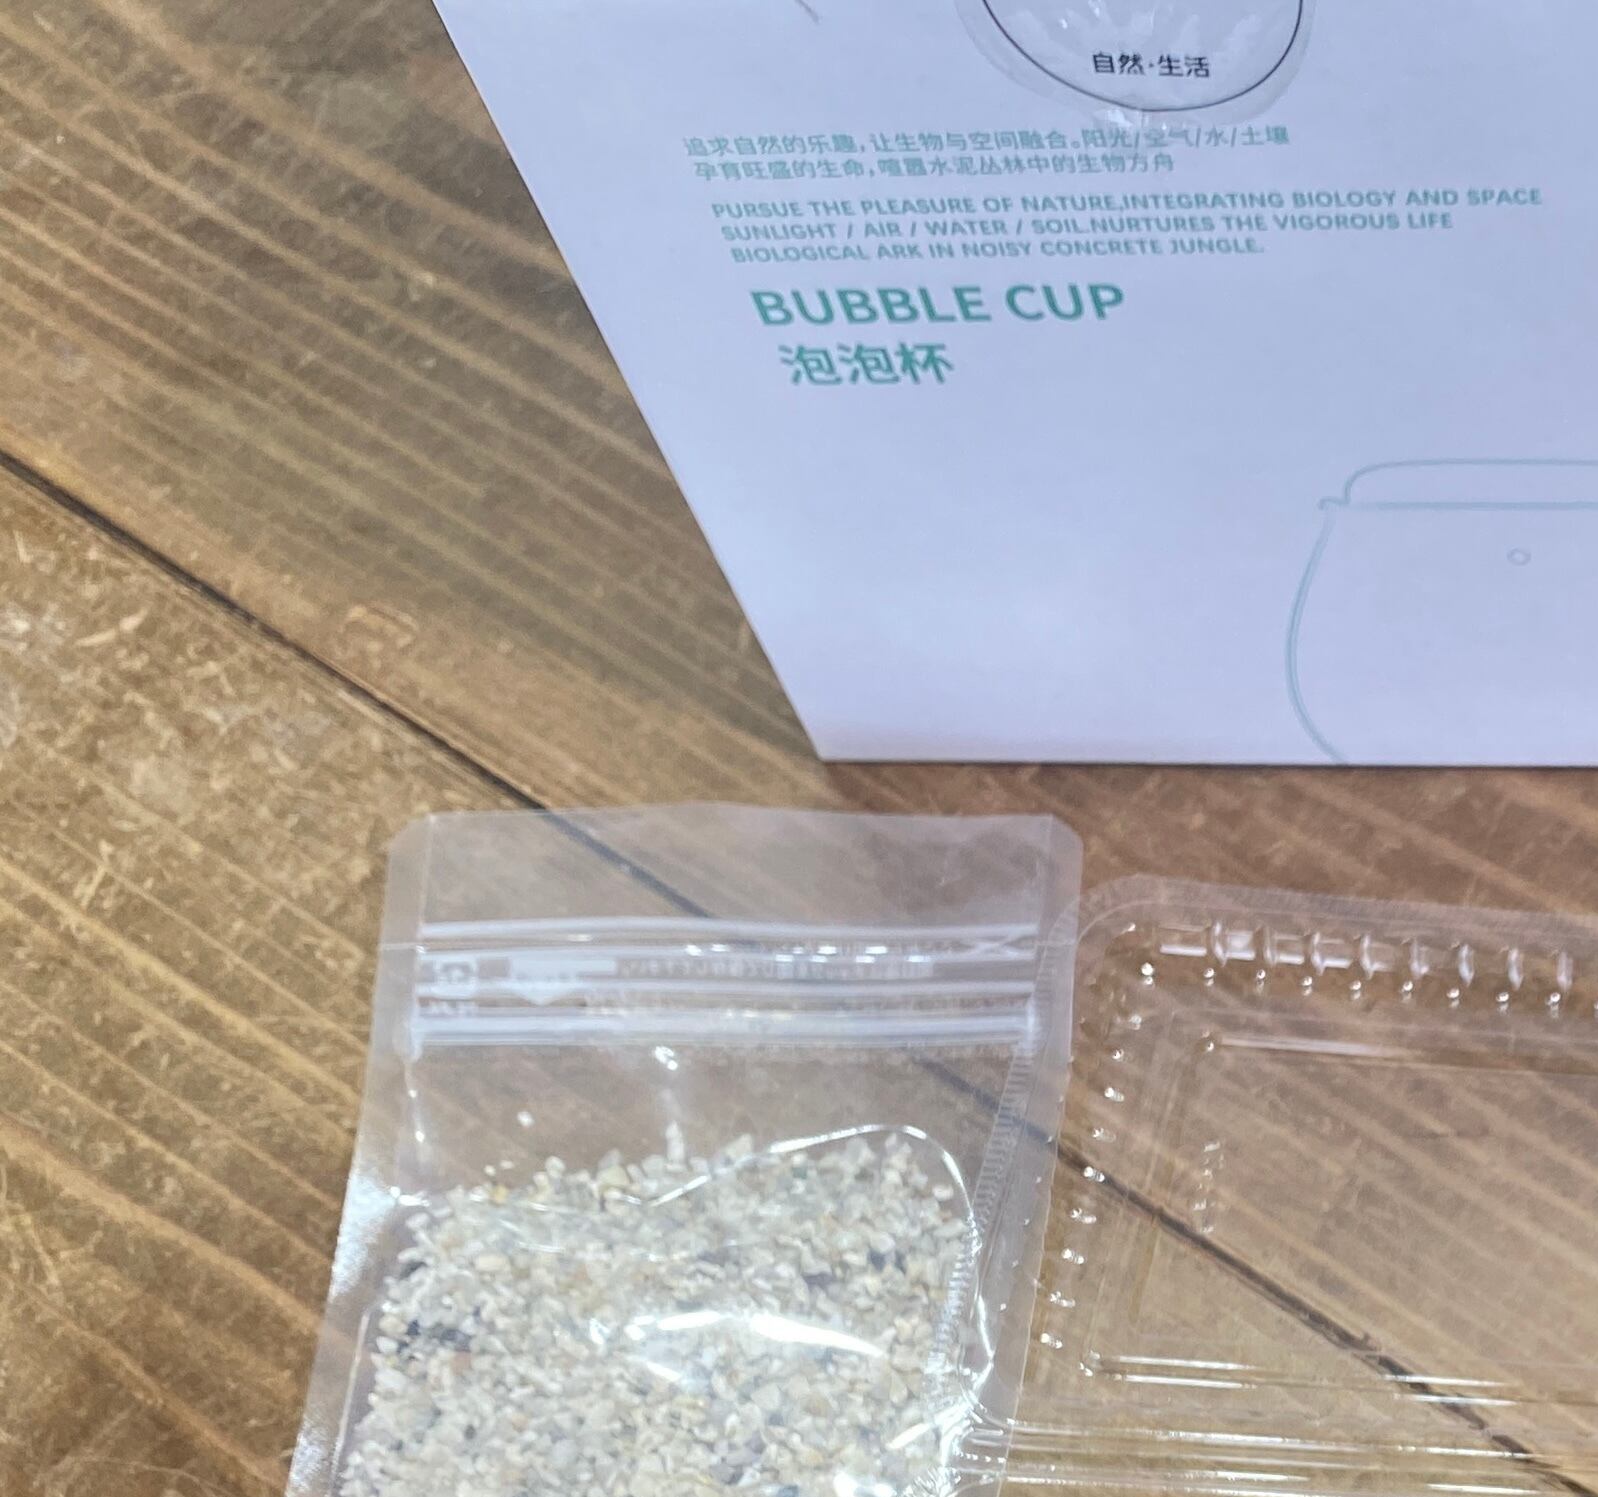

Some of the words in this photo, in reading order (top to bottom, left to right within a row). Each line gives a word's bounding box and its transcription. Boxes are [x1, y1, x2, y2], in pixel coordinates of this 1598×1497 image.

[1091, 49, 1211, 79] 自然·生活
[711, 201, 804, 220] PURSUE
[807, 199, 855, 217] THE
[859, 197, 977, 216] PLEASURE
[982, 196, 1013, 213] OF
[1291, 189, 1397, 209] BIOLOGY
[1405, 188, 1459, 207] AND
[1466, 187, 1543, 207] SPACE
[720, 222, 836, 242] SUNLIGHT
[863, 220, 902, 238] AIR
[923, 219, 1008, 237] WATER
[1220, 213, 1268, 232] THE
[1272, 212, 1401, 231] VIGOROUS
[1406, 211, 1453, 230] LIFE
[730, 244, 870, 263] BIOLOGICAL
[876, 243, 923, 260] ARK
[929, 242, 955, 259] IN
[961, 240, 1031, 258] NOISY
[1040, 237, 1163, 257] CONCRETE
[1170, 236, 1265, 255] JUNGLE.
[750, 285, 992, 327] BUBBLE
[1004, 282, 1126, 323] CUP
[777, 342, 956, 387] 泡泡杯
